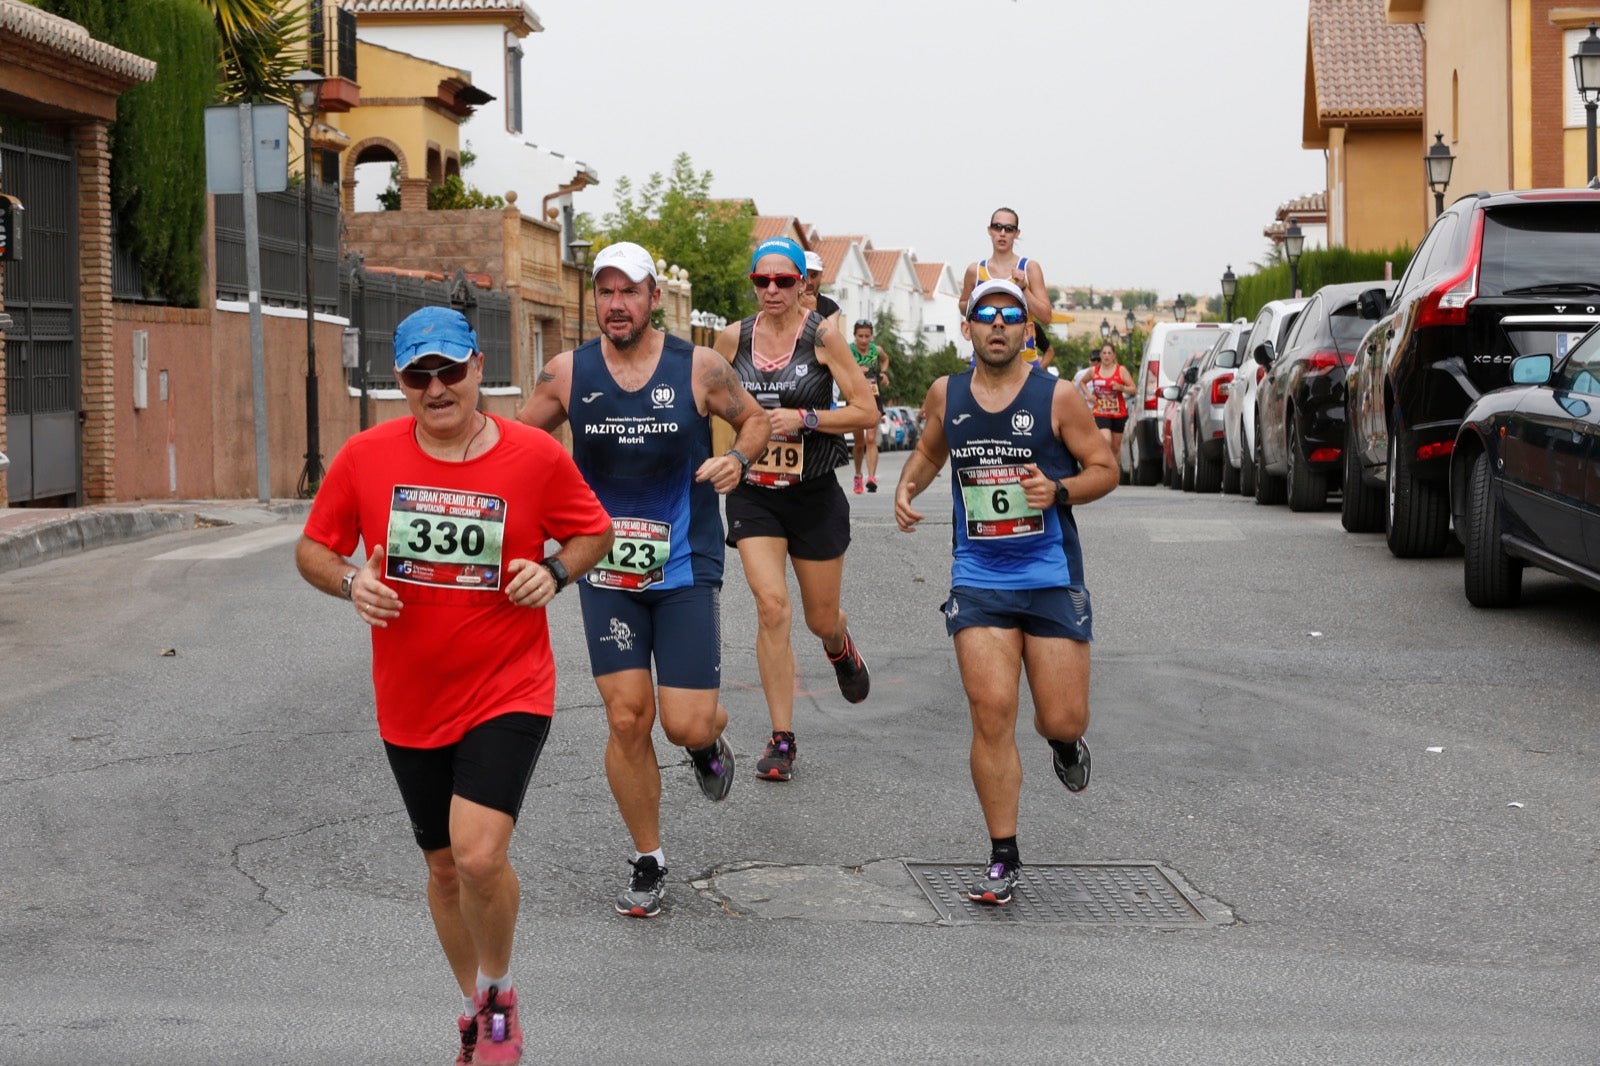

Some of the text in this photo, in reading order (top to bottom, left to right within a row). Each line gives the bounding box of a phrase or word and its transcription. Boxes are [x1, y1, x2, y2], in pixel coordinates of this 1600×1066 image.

[655, 388, 670, 401] 30
[1015, 414, 1030, 427] 30
[585, 422, 678, 434] PAZITO a PAZITO
[618, 436, 644, 444] Motril
[951, 446, 1032, 458] PAZITO a PAZITO
[980, 457, 1002, 465] Motril
[418, 491, 437, 503] GRAN
[439, 493, 465, 506] PREMIO
[466, 496, 476, 507] DE
[992, 489, 1009, 514] 6
[621, 521, 640, 530] PREMIO
[640, 522, 649, 531] DE
[408, 518, 485, 557] 330
